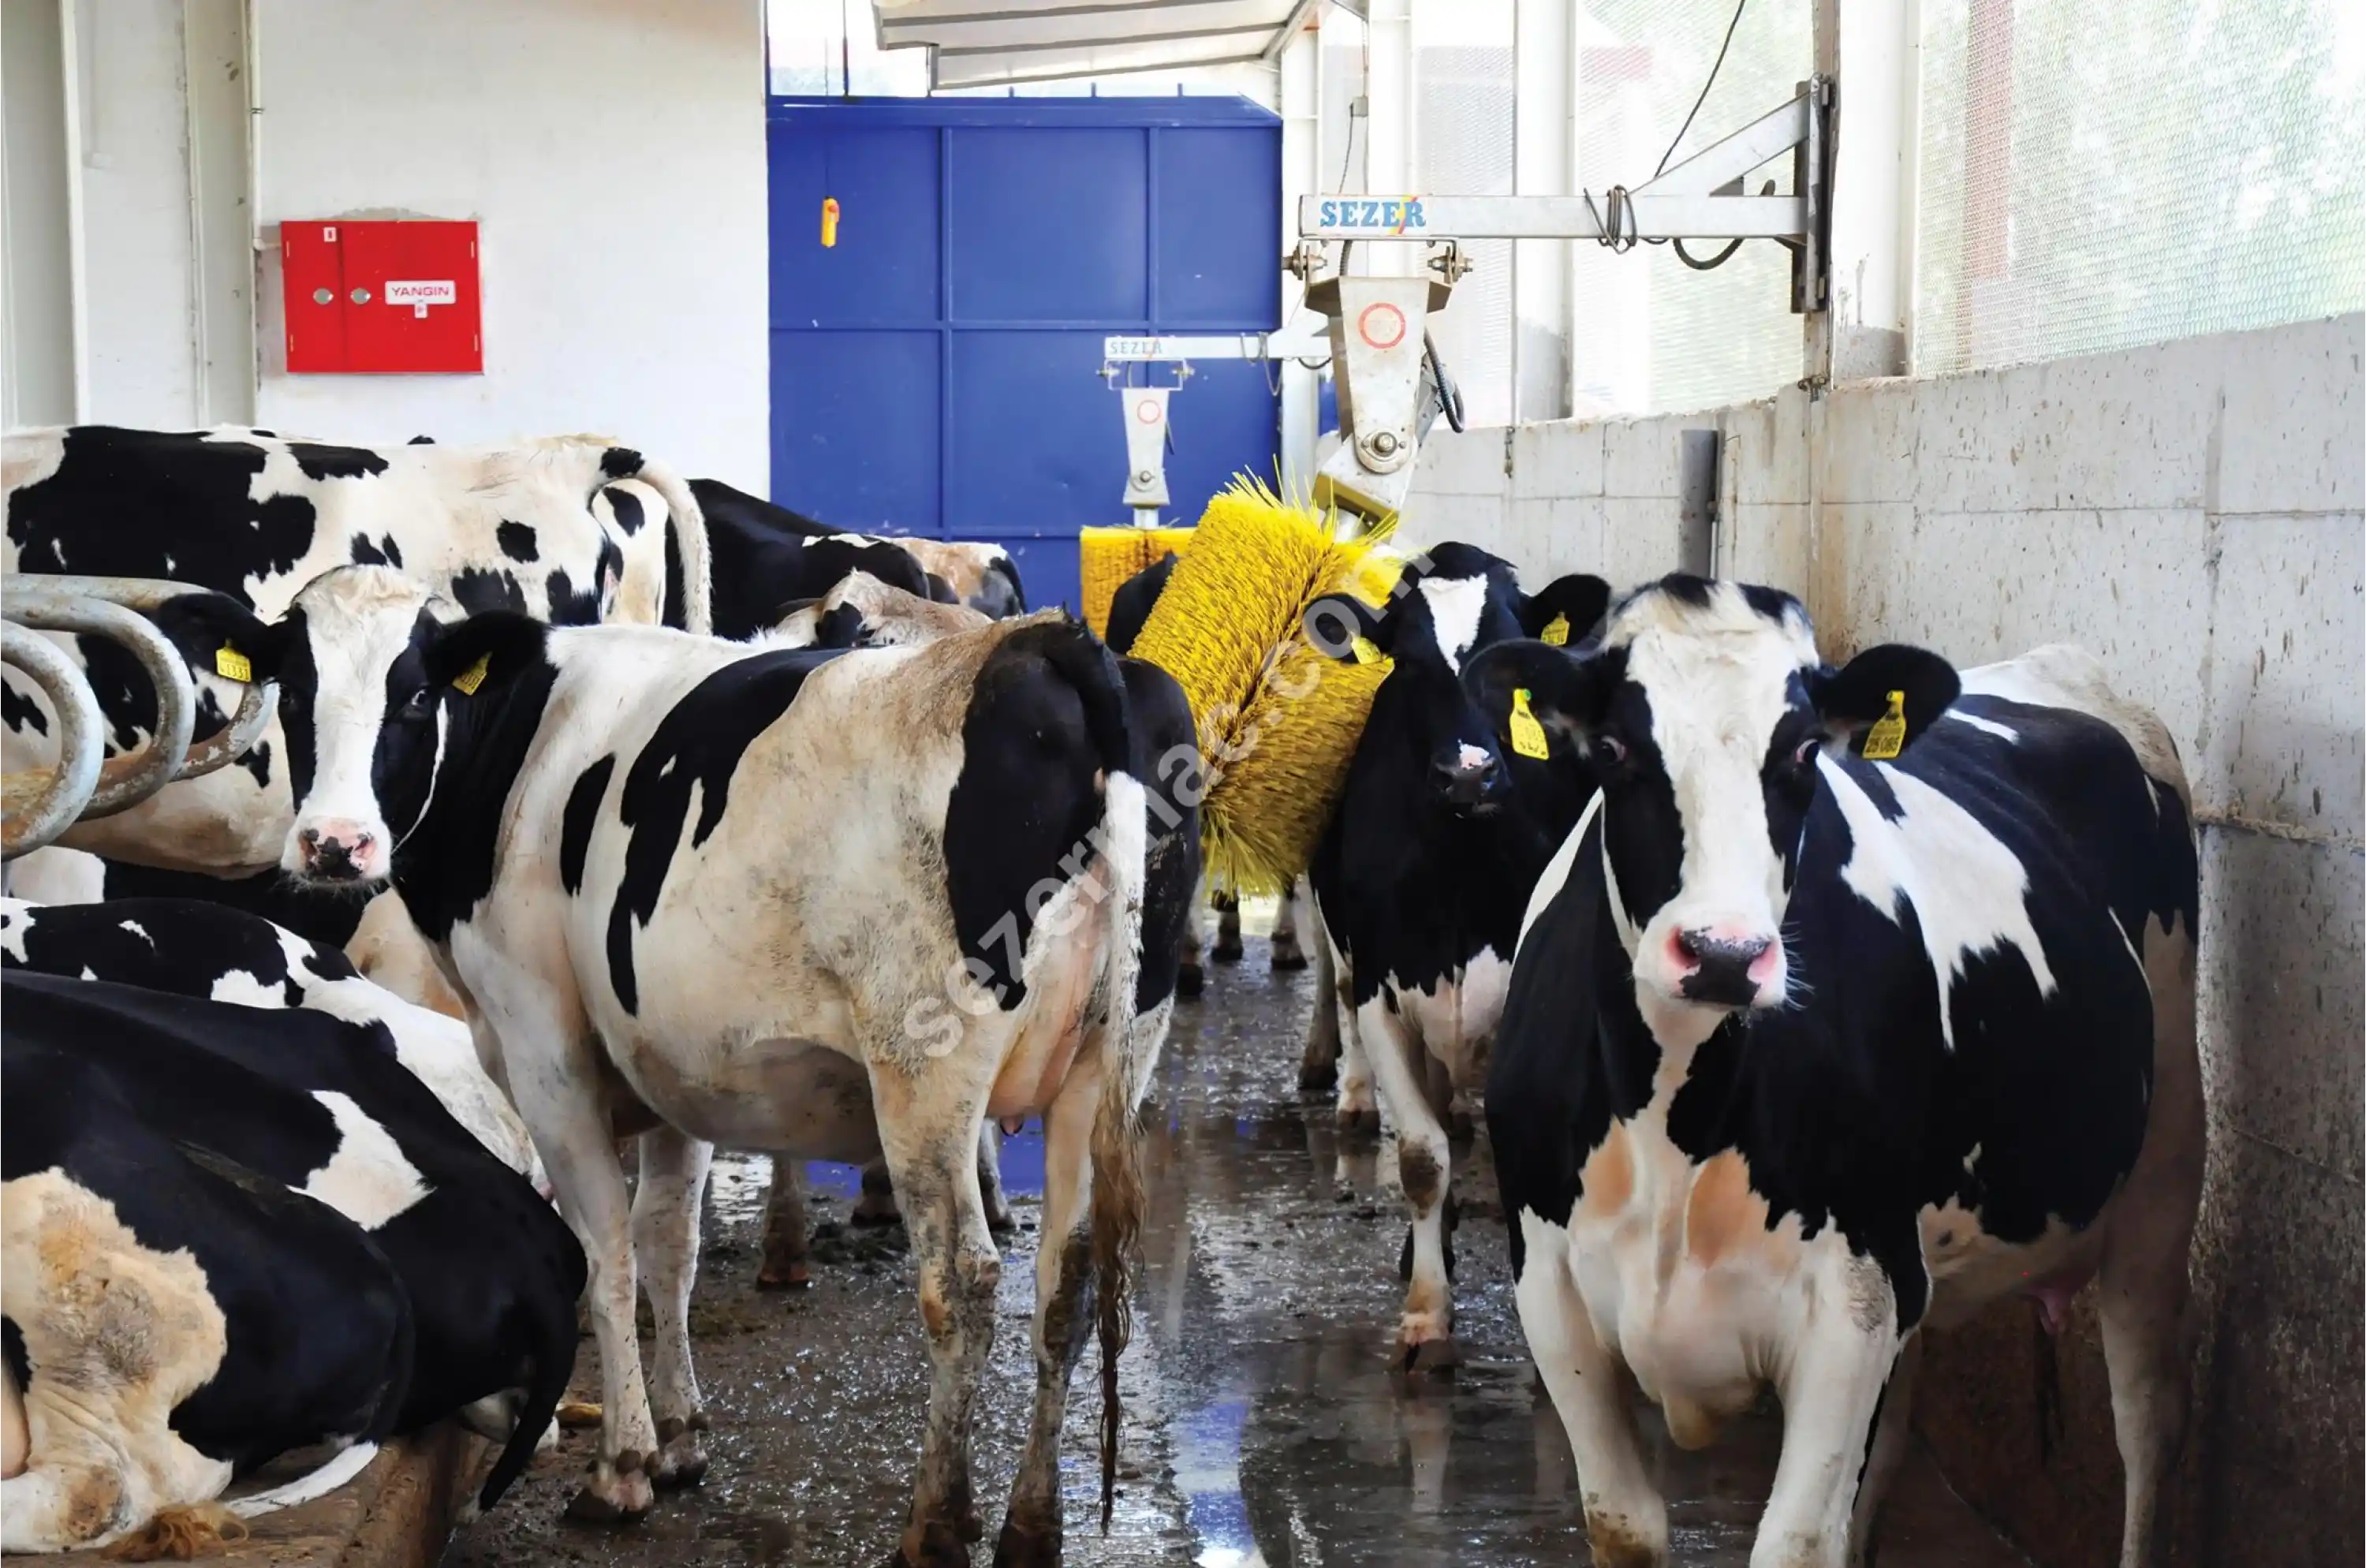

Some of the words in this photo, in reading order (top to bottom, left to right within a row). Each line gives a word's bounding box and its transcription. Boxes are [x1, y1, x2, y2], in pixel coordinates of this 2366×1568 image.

[1319, 200, 1427, 227] SEZER
[391, 286, 449, 297] YANGIN
[1109, 340, 1163, 355] SEZER
